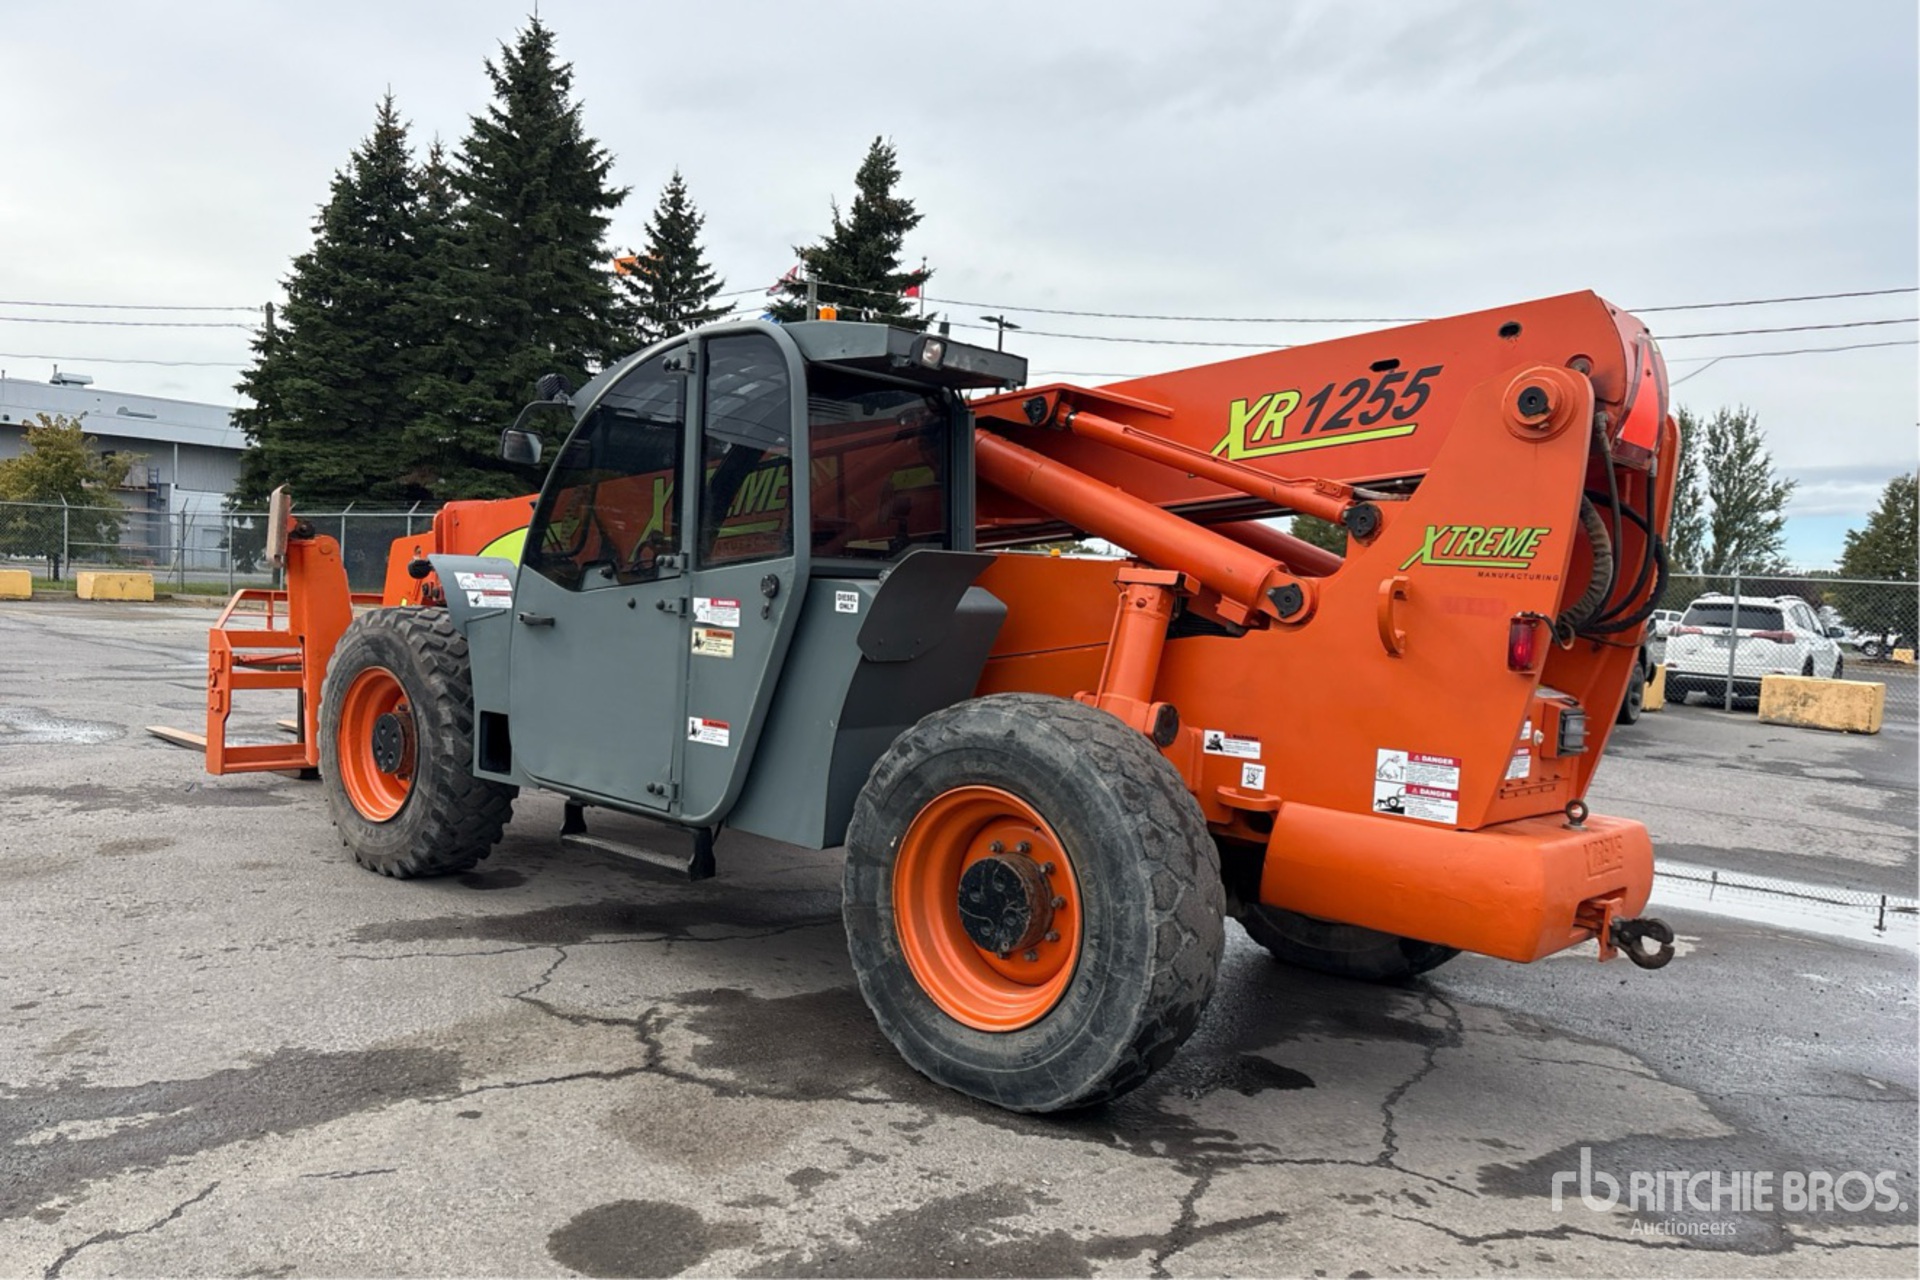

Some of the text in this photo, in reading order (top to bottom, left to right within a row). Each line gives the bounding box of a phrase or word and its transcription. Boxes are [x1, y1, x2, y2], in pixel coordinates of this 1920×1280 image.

[1301, 365, 1444, 434] 1255
[1399, 525, 1551, 571] XTREME
[1477, 571, 1559, 582] MANUFACTURING
[1421, 755, 1454, 766] DANGER
[1419, 788, 1453, 799] DANGER
